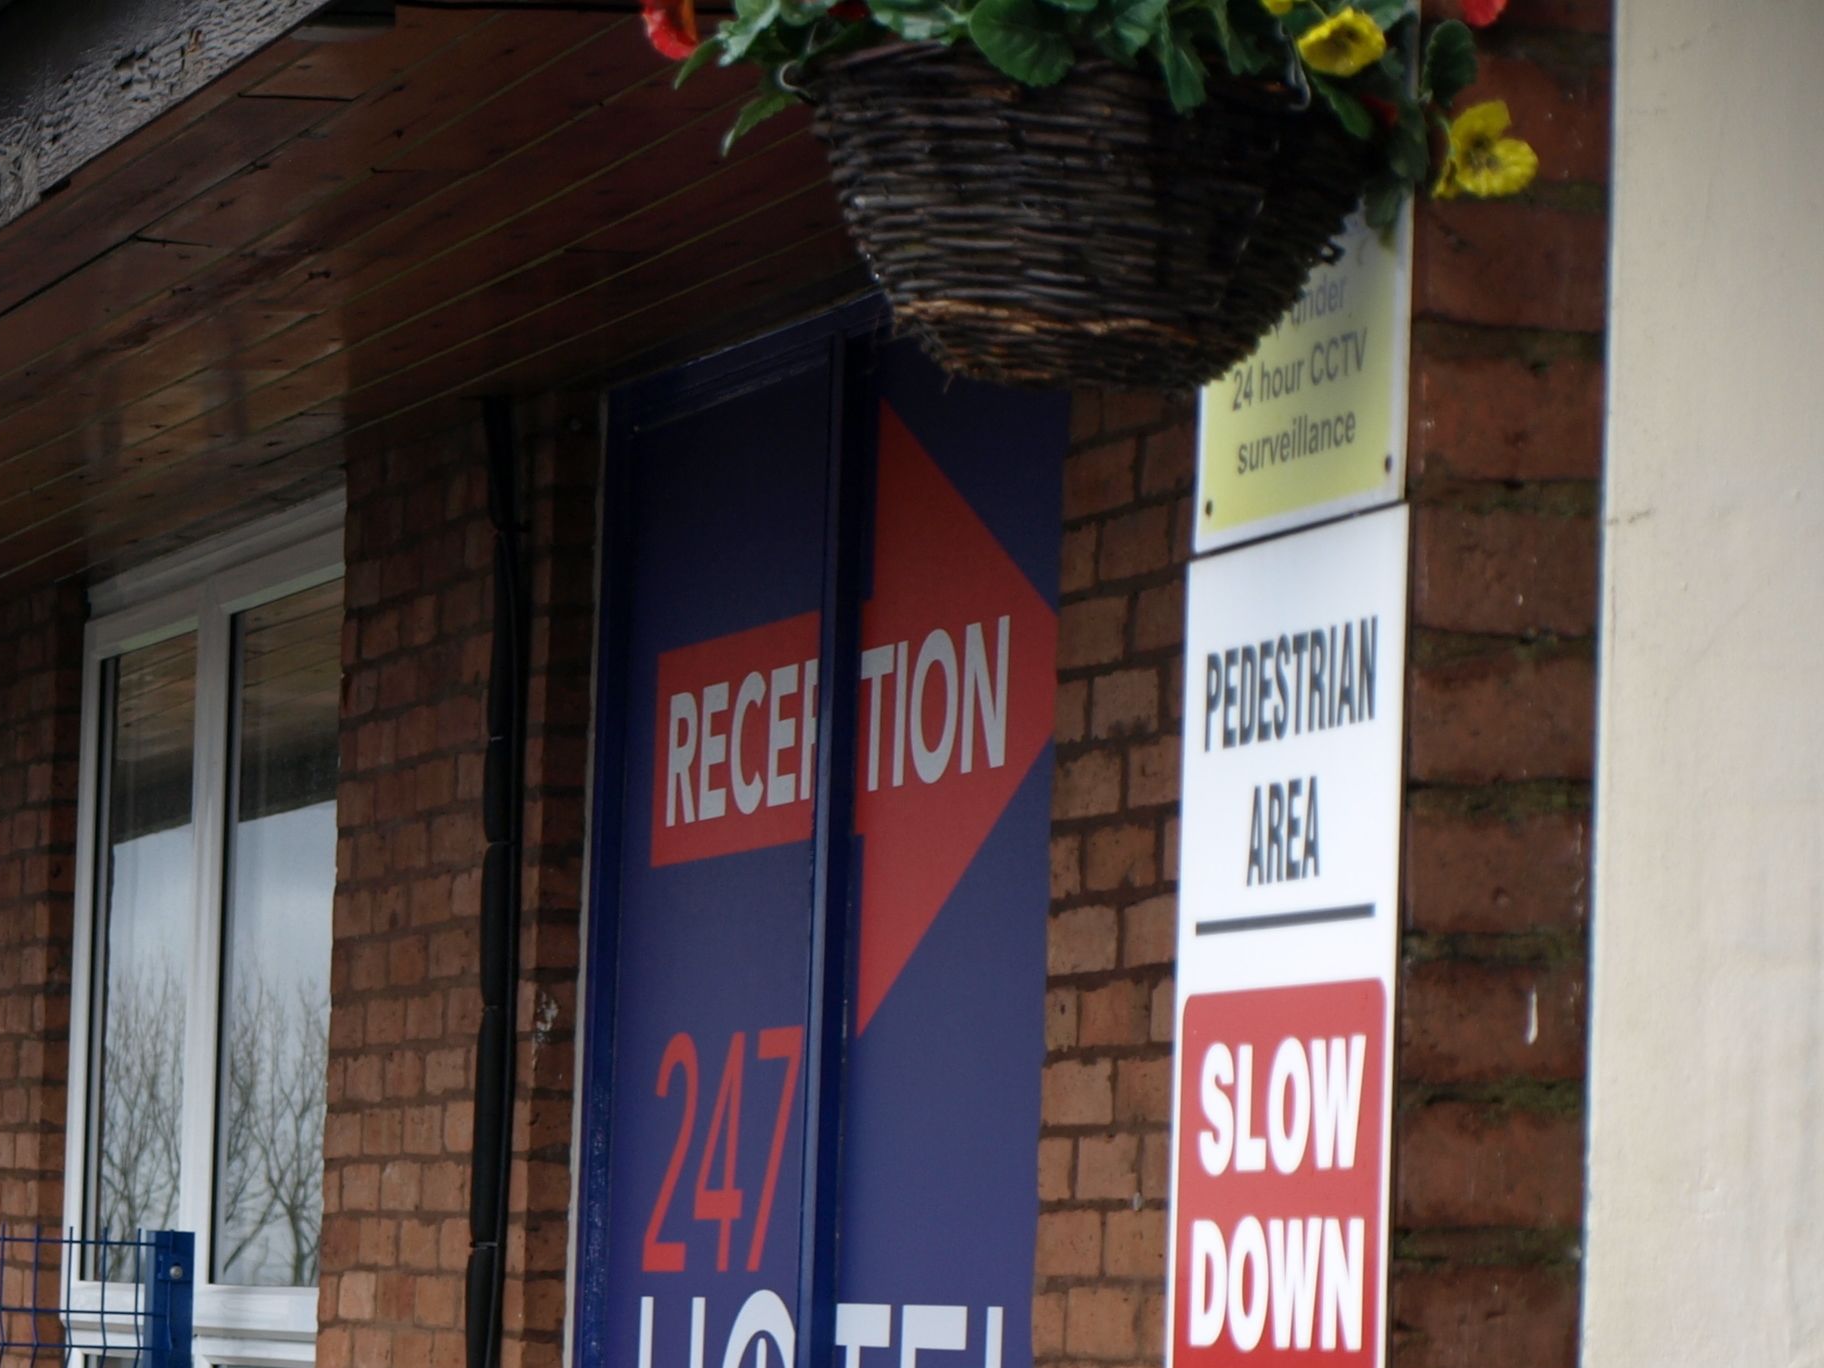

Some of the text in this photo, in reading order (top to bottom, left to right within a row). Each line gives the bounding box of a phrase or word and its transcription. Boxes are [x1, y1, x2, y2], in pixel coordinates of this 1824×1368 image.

[1232, 325, 1368, 412] 24 hour CCTV
[1237, 411, 1356, 474] surveillance
[1204, 615, 1378, 752] PEDESTRIAN
[1246, 775, 1320, 886] AREA
[642, 1025, 804, 1272] 247
[1198, 1034, 1366, 1176] SLOW
[1189, 1215, 1365, 1351] DOWN
